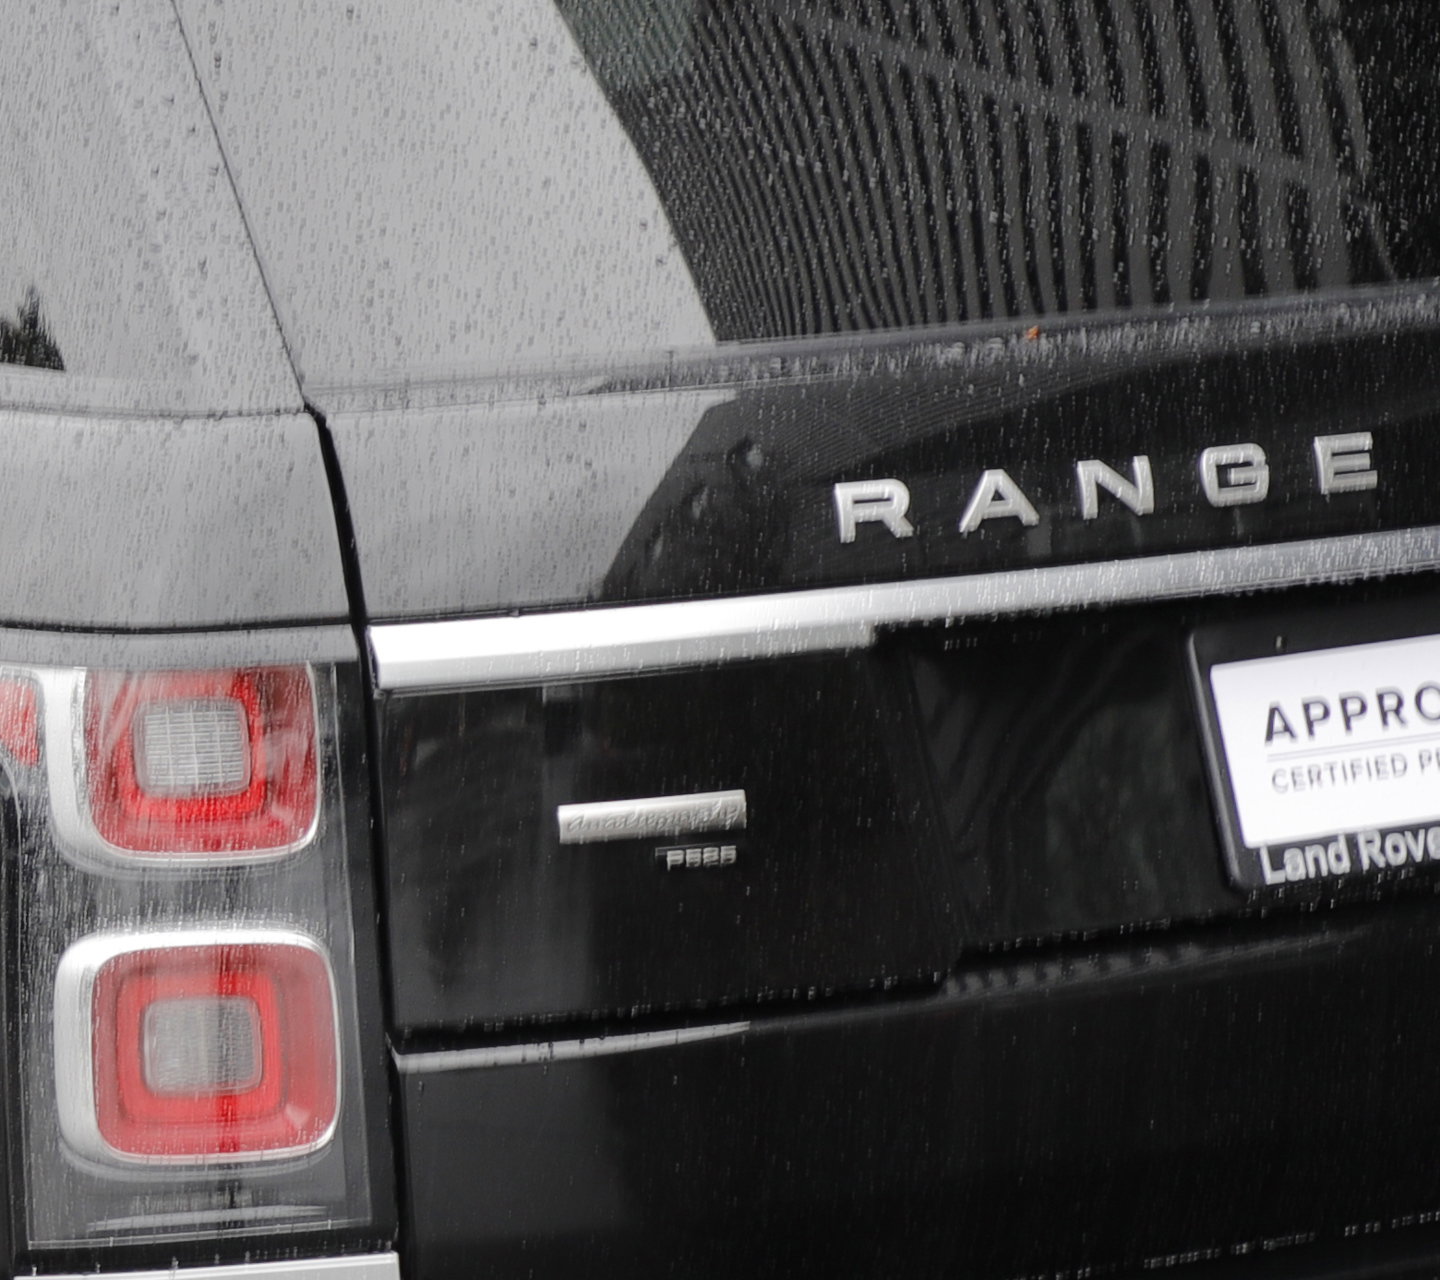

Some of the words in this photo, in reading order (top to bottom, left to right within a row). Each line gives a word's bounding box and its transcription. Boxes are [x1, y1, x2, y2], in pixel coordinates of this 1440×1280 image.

[833, 431, 1378, 544] RANGE
[1271, 752, 1409, 794] CERTIFIED
[1260, 833, 1350, 886] Land
